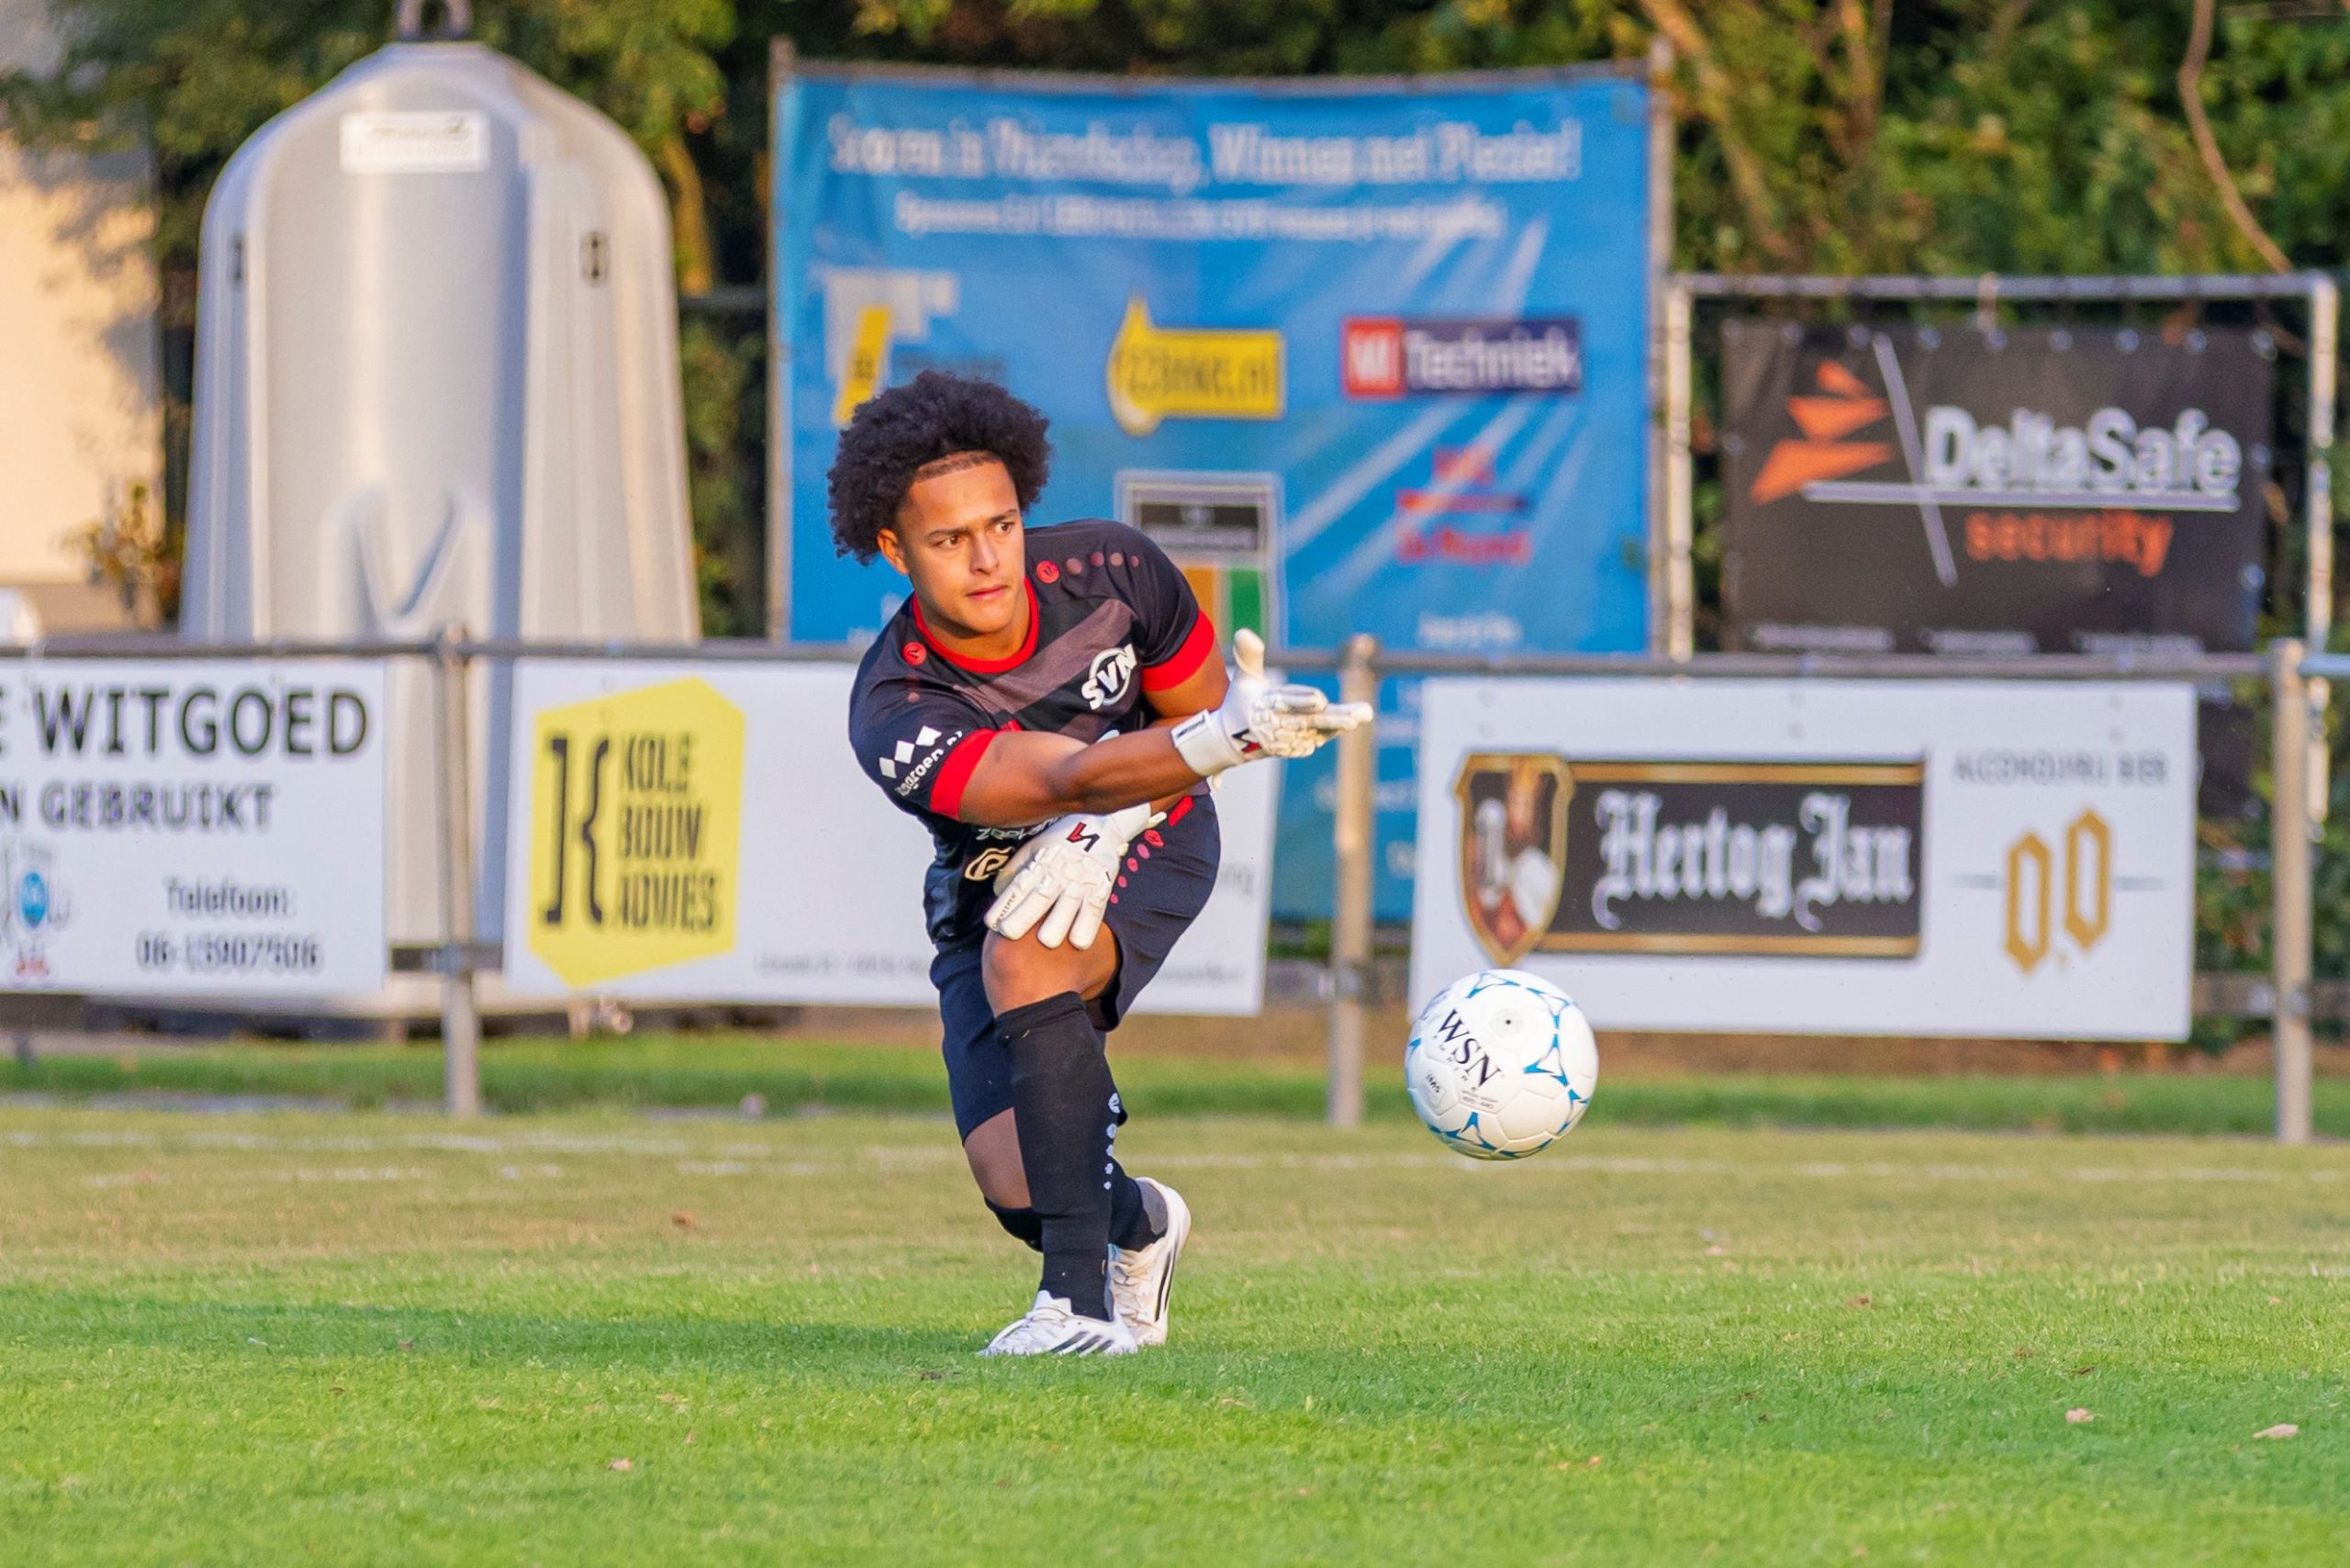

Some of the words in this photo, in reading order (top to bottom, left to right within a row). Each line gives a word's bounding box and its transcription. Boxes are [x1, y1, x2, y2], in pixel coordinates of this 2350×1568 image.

[1407, 330, 1580, 386] Techniek
[1924, 406, 2242, 493] DeltaSafe
[1964, 510, 2174, 577] security
[1080, 643, 1137, 711] SVN
[35, 688, 368, 756] WITGOED
[40, 782, 274, 829] GEBRUIKT
[621, 805, 703, 860] BOUW
[1592, 790, 1797, 931] Hertog
[1794, 792, 1916, 933] Jan
[619, 874, 717, 930] ADVIES
[1438, 1008, 1501, 1088] WSN
